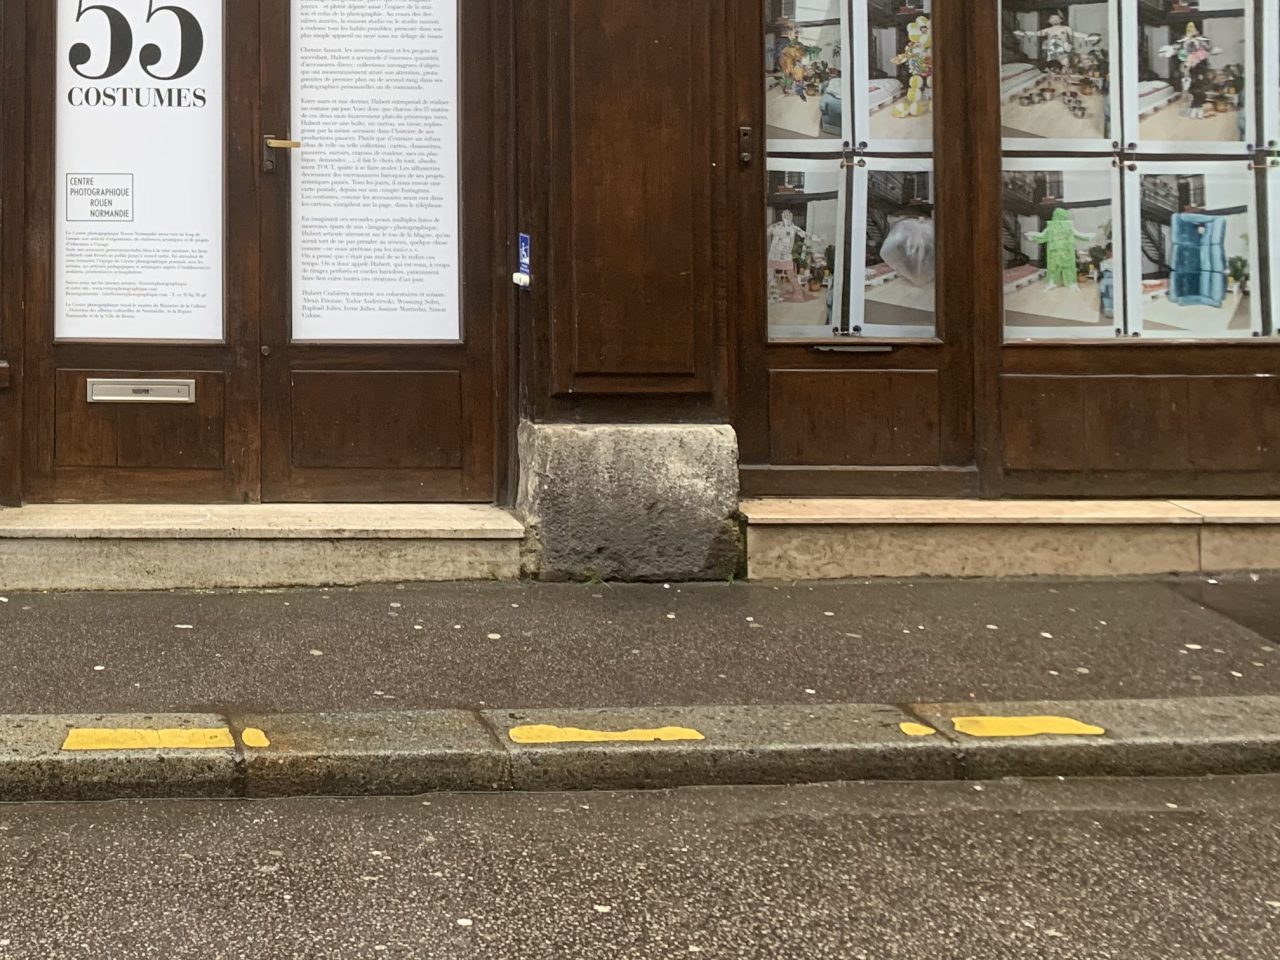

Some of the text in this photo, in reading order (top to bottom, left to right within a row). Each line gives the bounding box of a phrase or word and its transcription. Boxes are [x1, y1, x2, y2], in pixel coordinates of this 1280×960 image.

[68, 87, 207, 107] COSTUMES
[70, 178, 94, 186] CENTRE
[70, 188, 130, 196] PHOTOGRAPHIQUE
[90, 210, 129, 218] NORMANDIE
